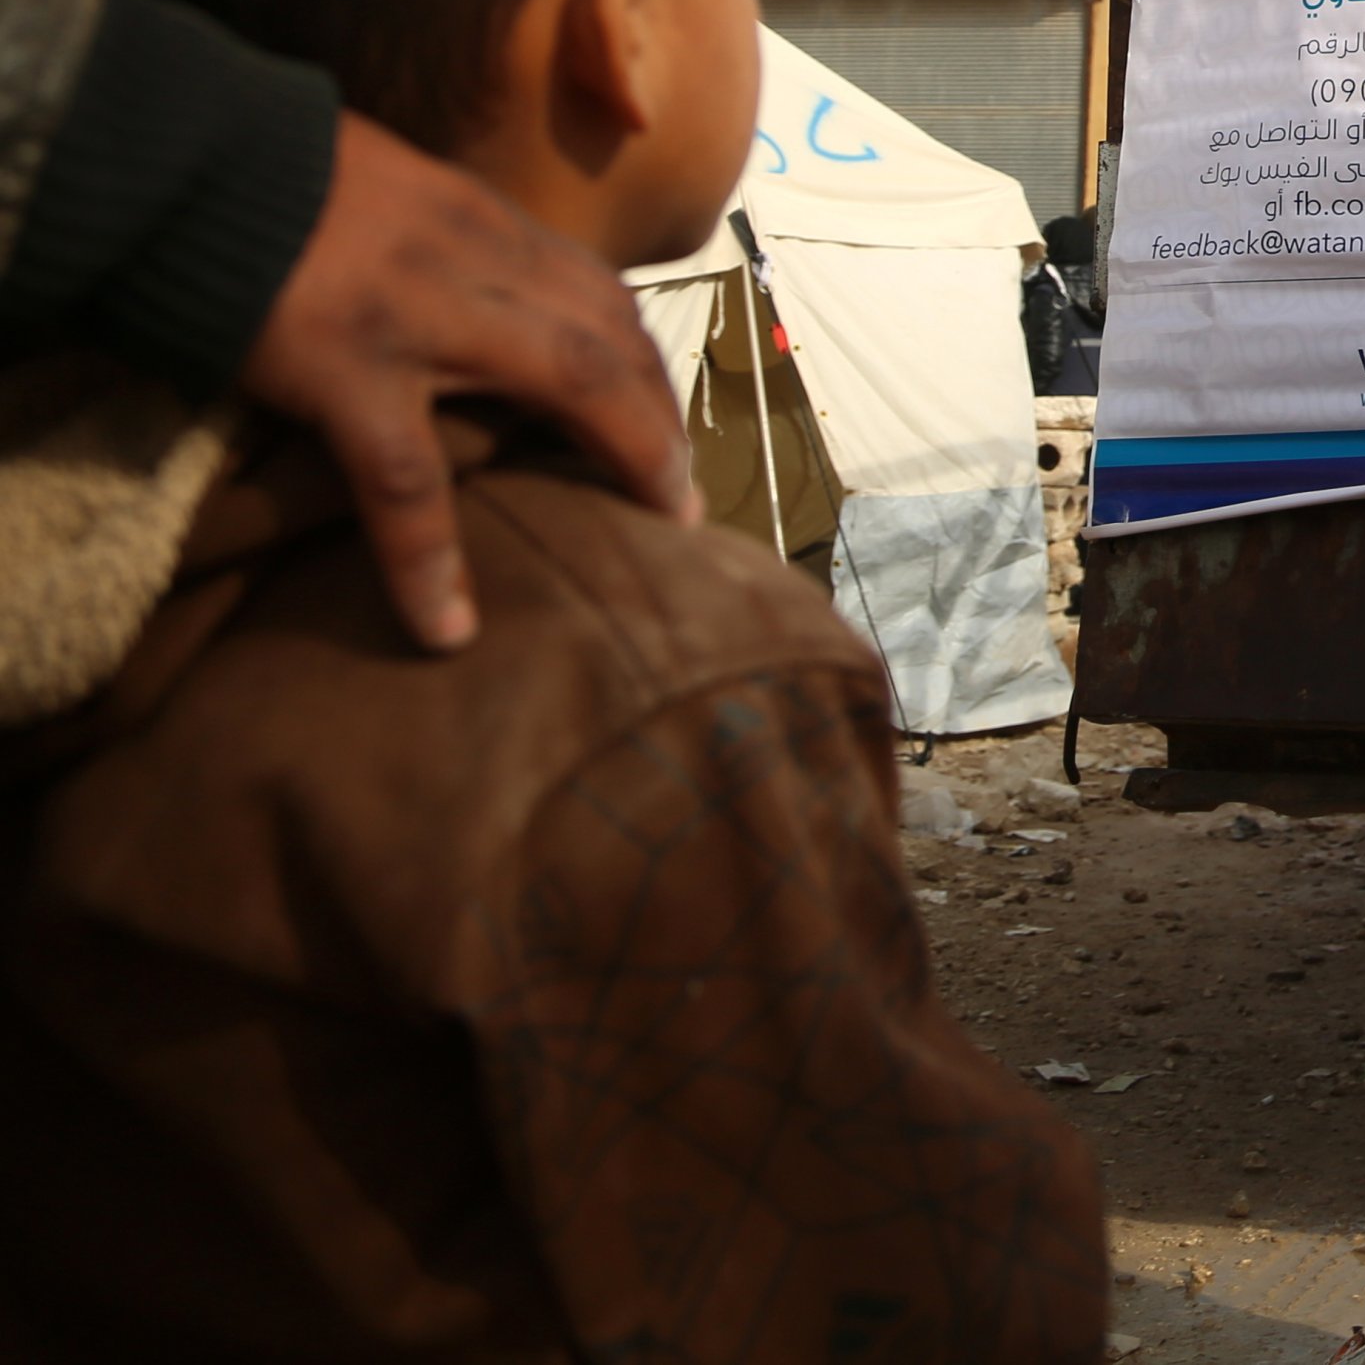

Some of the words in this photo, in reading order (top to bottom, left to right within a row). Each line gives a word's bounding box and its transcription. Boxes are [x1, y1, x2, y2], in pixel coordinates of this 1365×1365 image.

[1209, 129, 1240, 152] مع
[1245, 118, 1336, 148] التواصل
[1200, 163, 1241, 187] بوك
[1246, 156, 1327, 185] الفيس
[1265, 189, 1283, 222] أو
